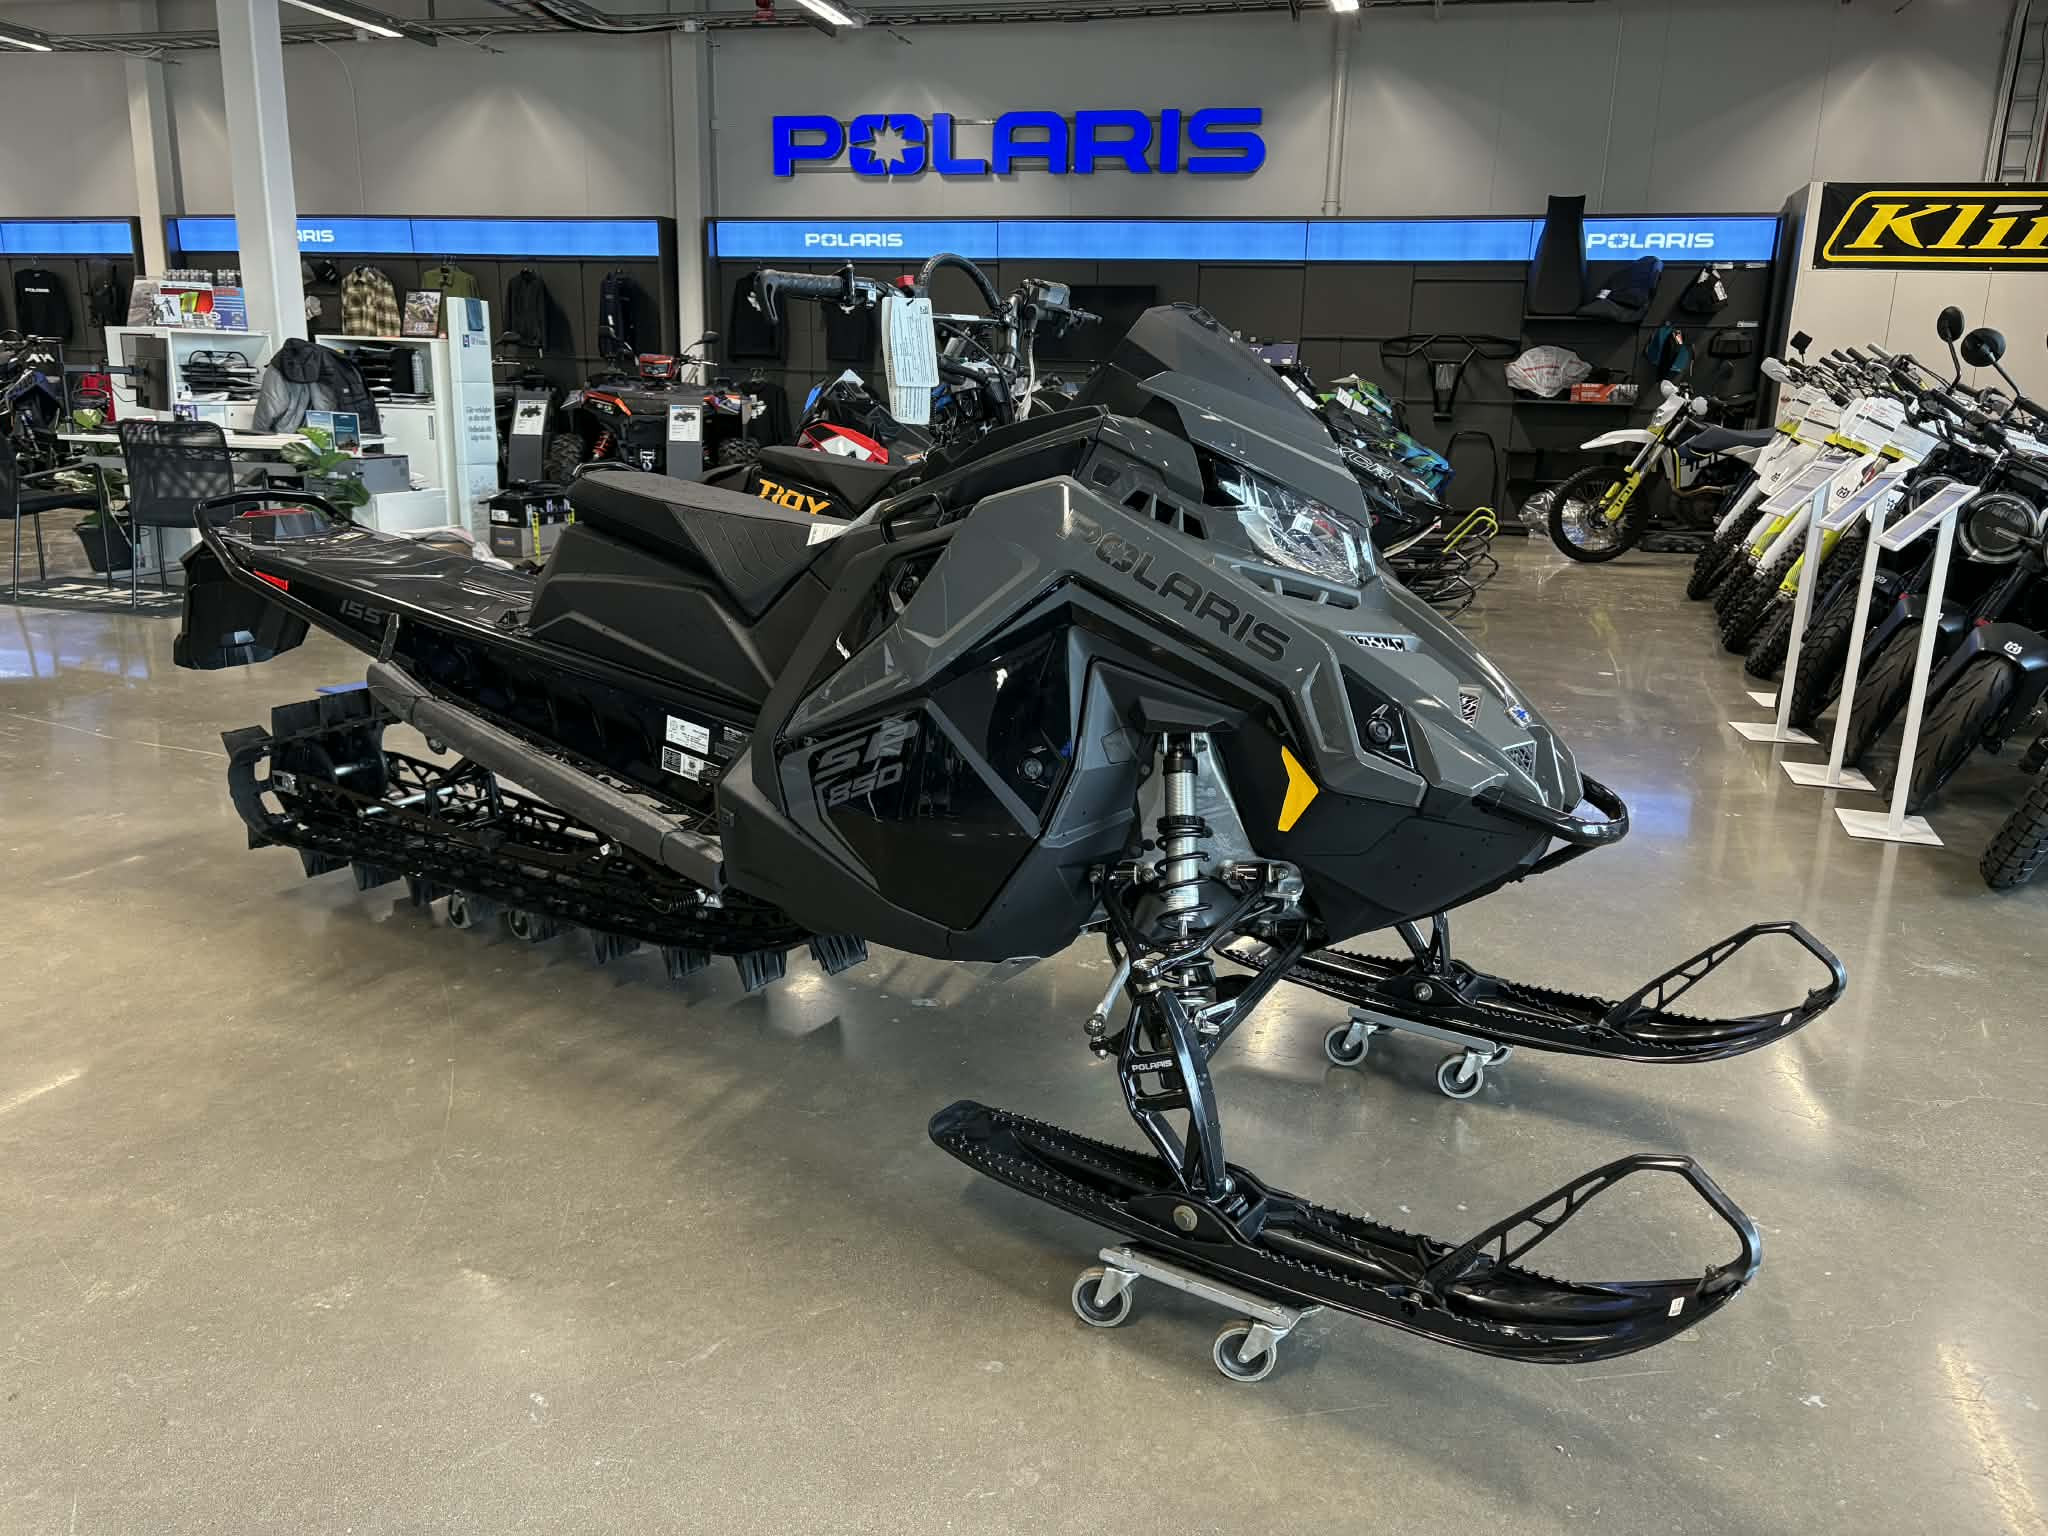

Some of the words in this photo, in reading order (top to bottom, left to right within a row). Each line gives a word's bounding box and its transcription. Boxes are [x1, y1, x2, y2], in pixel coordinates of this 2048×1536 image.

[773, 107, 1267, 178] POLARIS
[804, 232, 904, 248] POLARIS
[1585, 232, 1715, 249] POLARIS
[1058, 508, 1292, 663] POLARIS
[1131, 1059, 1173, 1072] POLARIS
